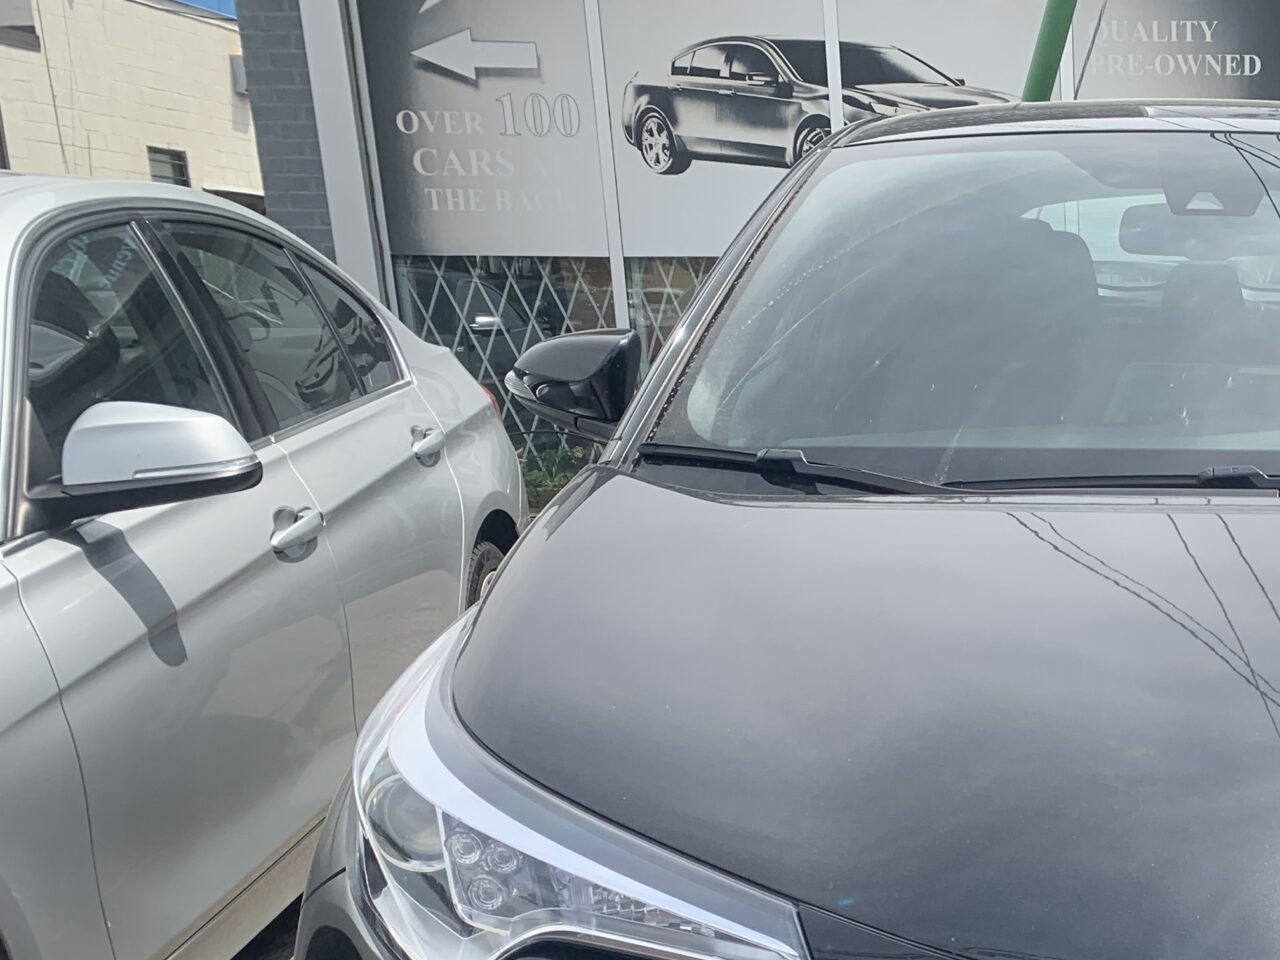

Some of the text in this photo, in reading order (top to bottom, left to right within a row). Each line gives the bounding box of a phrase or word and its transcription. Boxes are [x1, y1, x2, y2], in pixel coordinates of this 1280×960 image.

[1088, 20, 1219, 43] QUALITY
[1091, 54, 1262, 76] PRE-OWNED
[396, 92, 580, 137] OVER 100
[413, 148, 514, 177] CARS
[424, 188, 485, 212] THE
